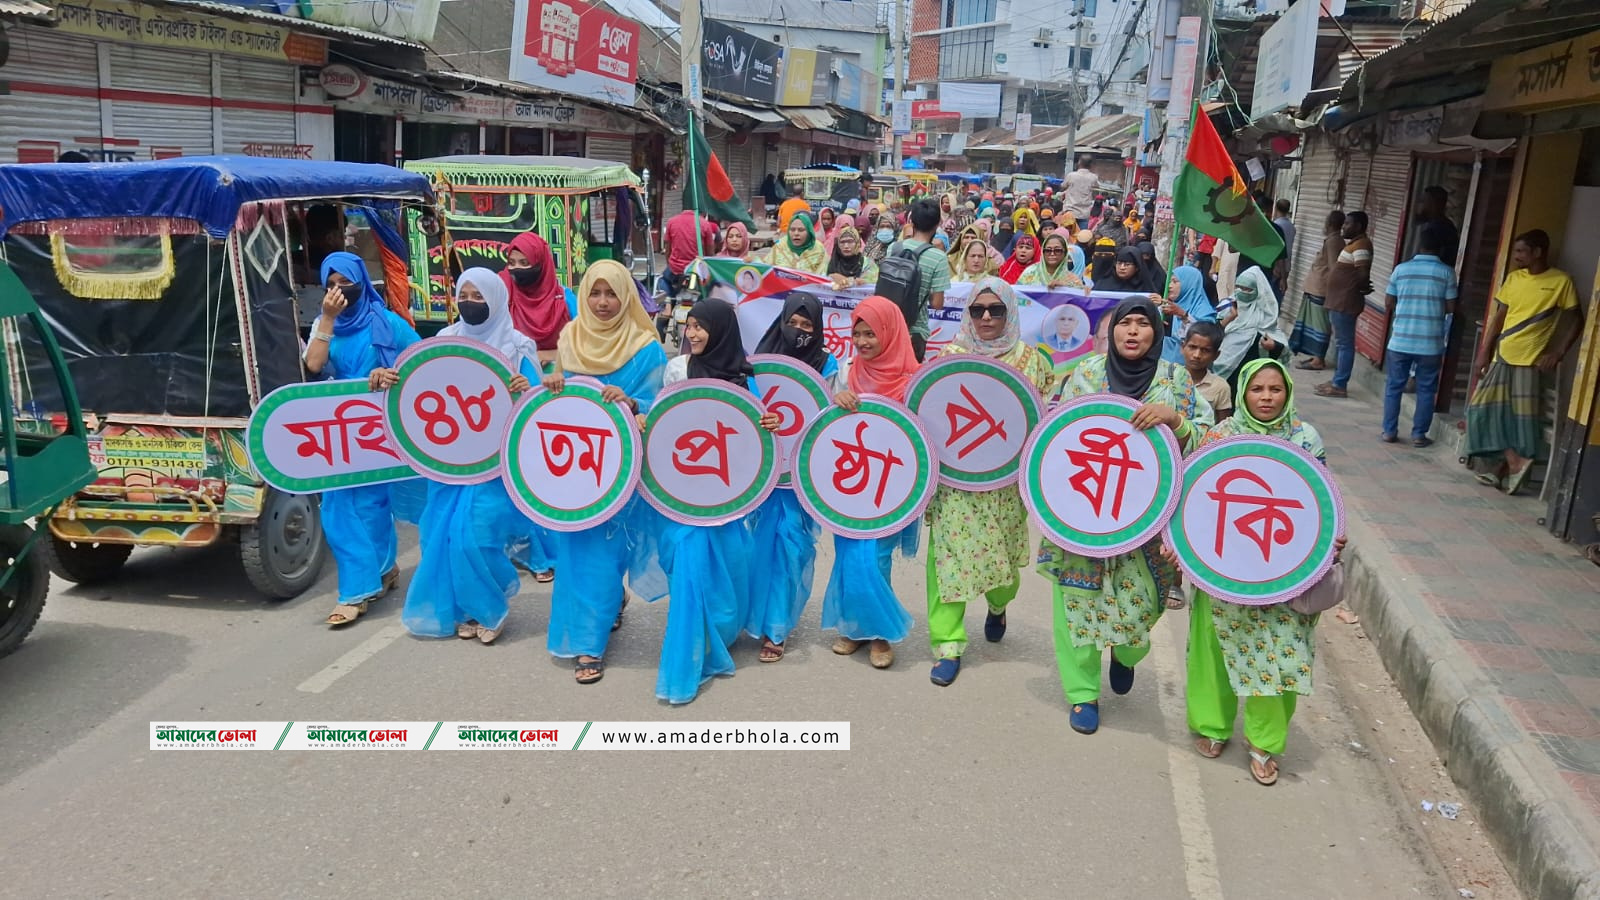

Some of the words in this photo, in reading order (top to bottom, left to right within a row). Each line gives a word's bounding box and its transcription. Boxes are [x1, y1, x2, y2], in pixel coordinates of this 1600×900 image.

[373, 82, 417, 105] শাপলা
[414, 384, 496, 445] ৪৮
[945, 384, 1007, 460] বা
[106, 457, 203, 469] 01711-931430
[536, 421, 614, 489] তম
[672, 420, 740, 488] প্র
[831, 420, 905, 509] ষ্ঠা
[1064, 427, 1144, 521] র্ষী
[1206, 468, 1305, 563] কি
